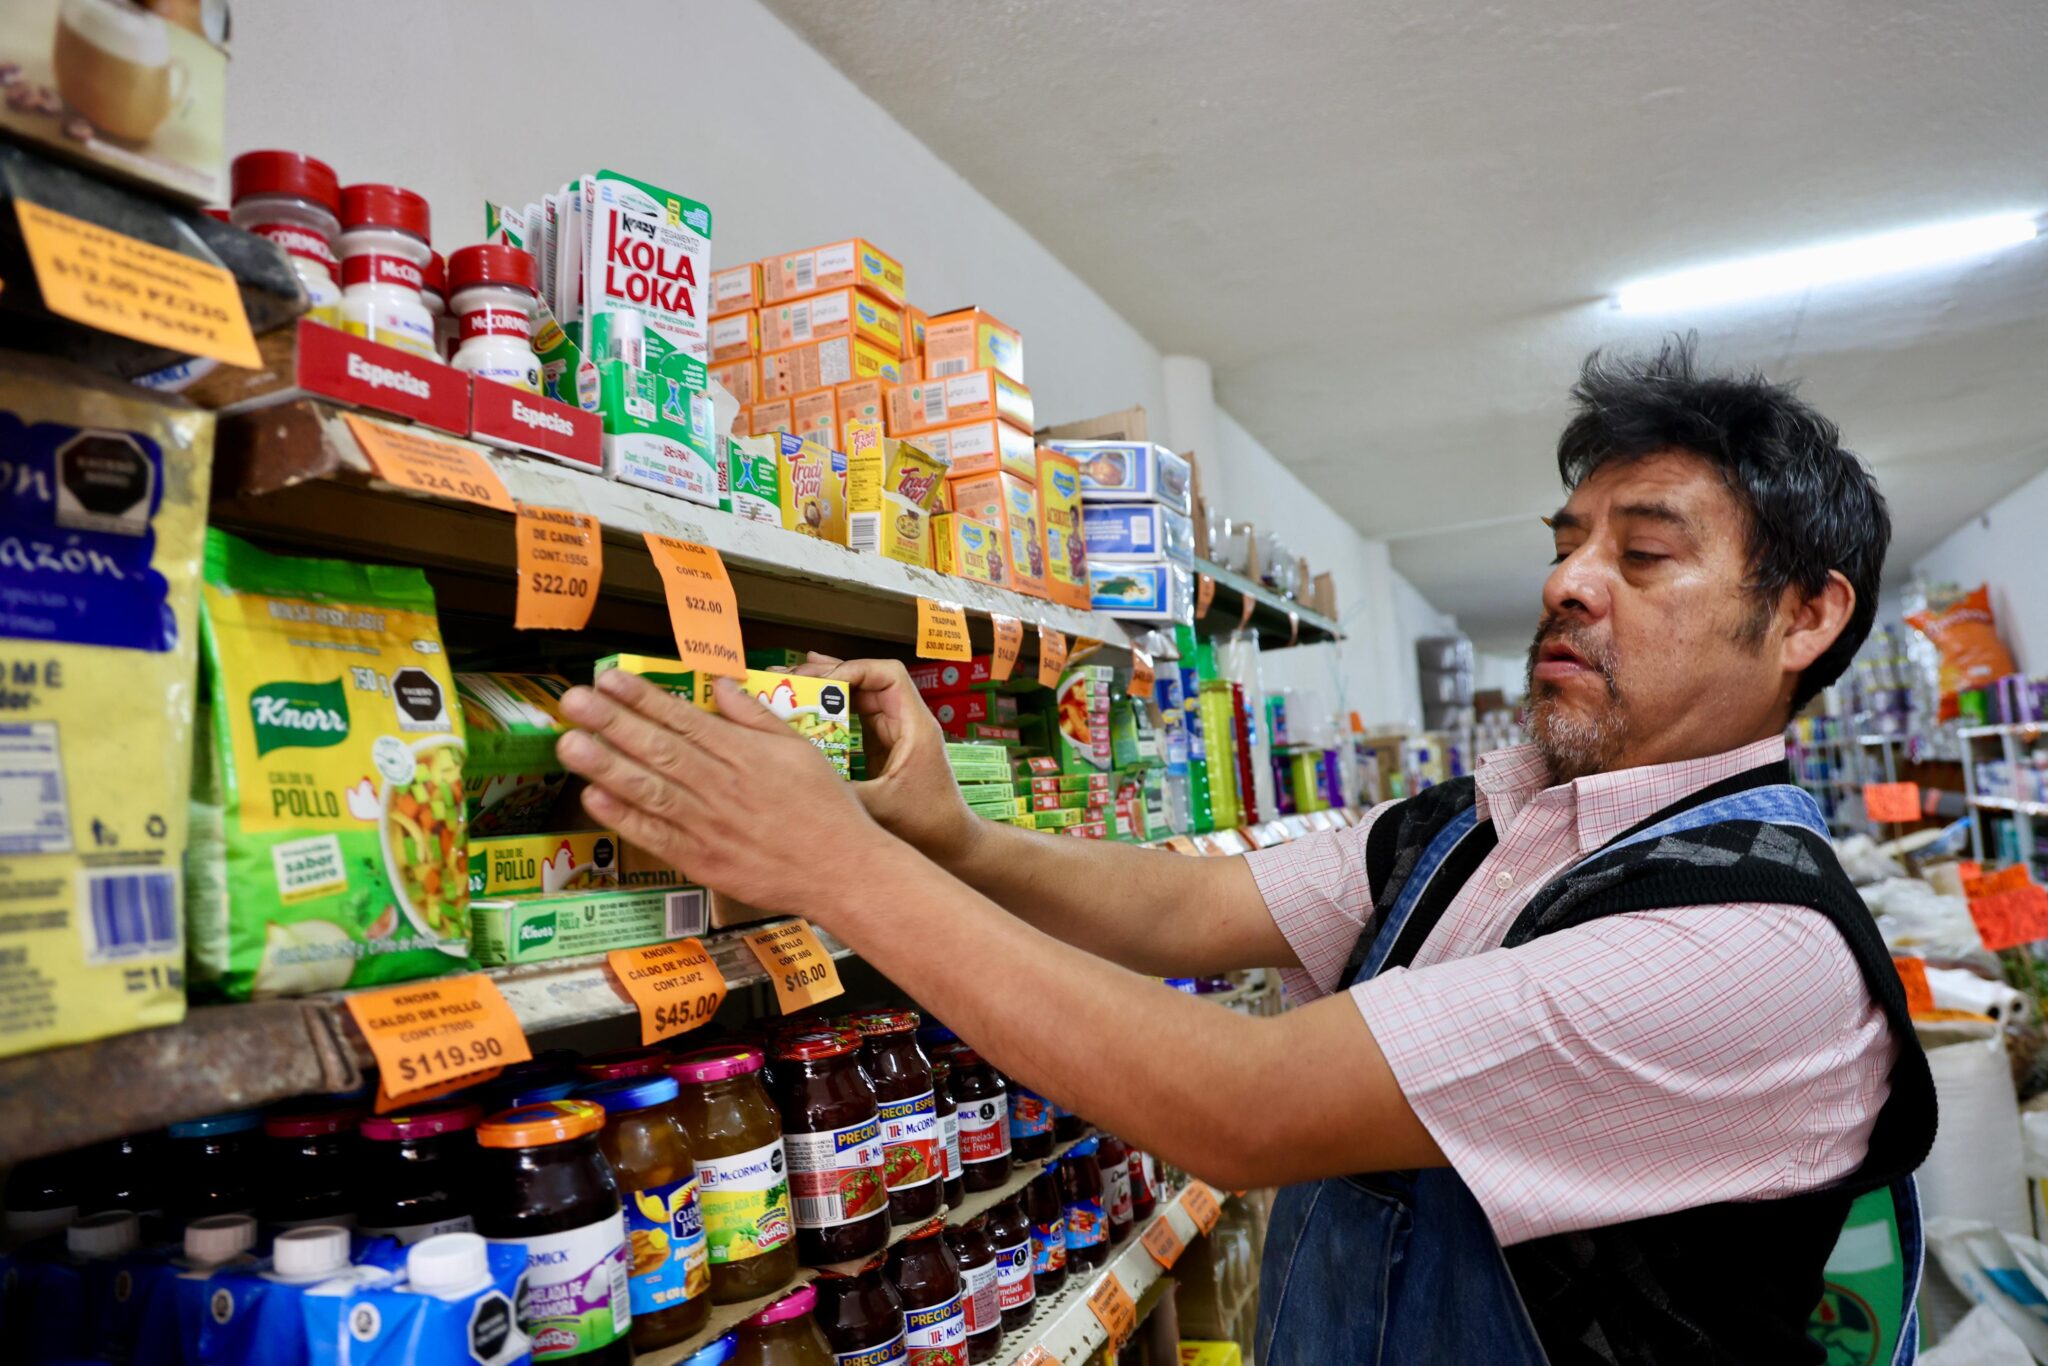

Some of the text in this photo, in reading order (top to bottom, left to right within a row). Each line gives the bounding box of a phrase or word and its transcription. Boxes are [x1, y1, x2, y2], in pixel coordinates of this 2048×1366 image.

[608, 209, 696, 287] KOLA
[606, 264, 695, 317] LOKA
[347, 352, 430, 399] Especias
[512, 399, 574, 436] Especias
[788, 453, 823, 484] Tradi
[406, 468, 490, 500] $24.00
[794, 478, 821, 509] pan
[533, 528, 584, 547] DE CARNE
[684, 544, 706, 555] LOCA
[532, 572, 588, 598] $22.00
[685, 595, 722, 614] $22.00
[251, 695, 347, 732] Knorr
[272, 788, 340, 818] POLLO
[285, 853, 333, 873] sabor
[495, 858, 535, 883] POLLO
[286, 868, 338, 887] casero
[521, 925, 553, 941] Knorr
[755, 925, 802, 945] KNORR CALDO
[641, 946, 676, 960] KNORR
[770, 938, 803, 954] DE POLLO
[628, 954, 707, 980] CALDO DE POLLO
[785, 963, 826, 992] $18.00
[392, 991, 440, 1007] KNORR
[368, 1000, 482, 1030] CALDO DE POLLO
[655, 992, 718, 1033] $45.00
[398, 1037, 503, 1081] $119.90
[837, 1124, 877, 1147] PRECIO
[972, 1142, 991, 1153] Fresa
[720, 1161, 769, 1182] McCORMICK
[910, 1306, 951, 1327] PRECIO
